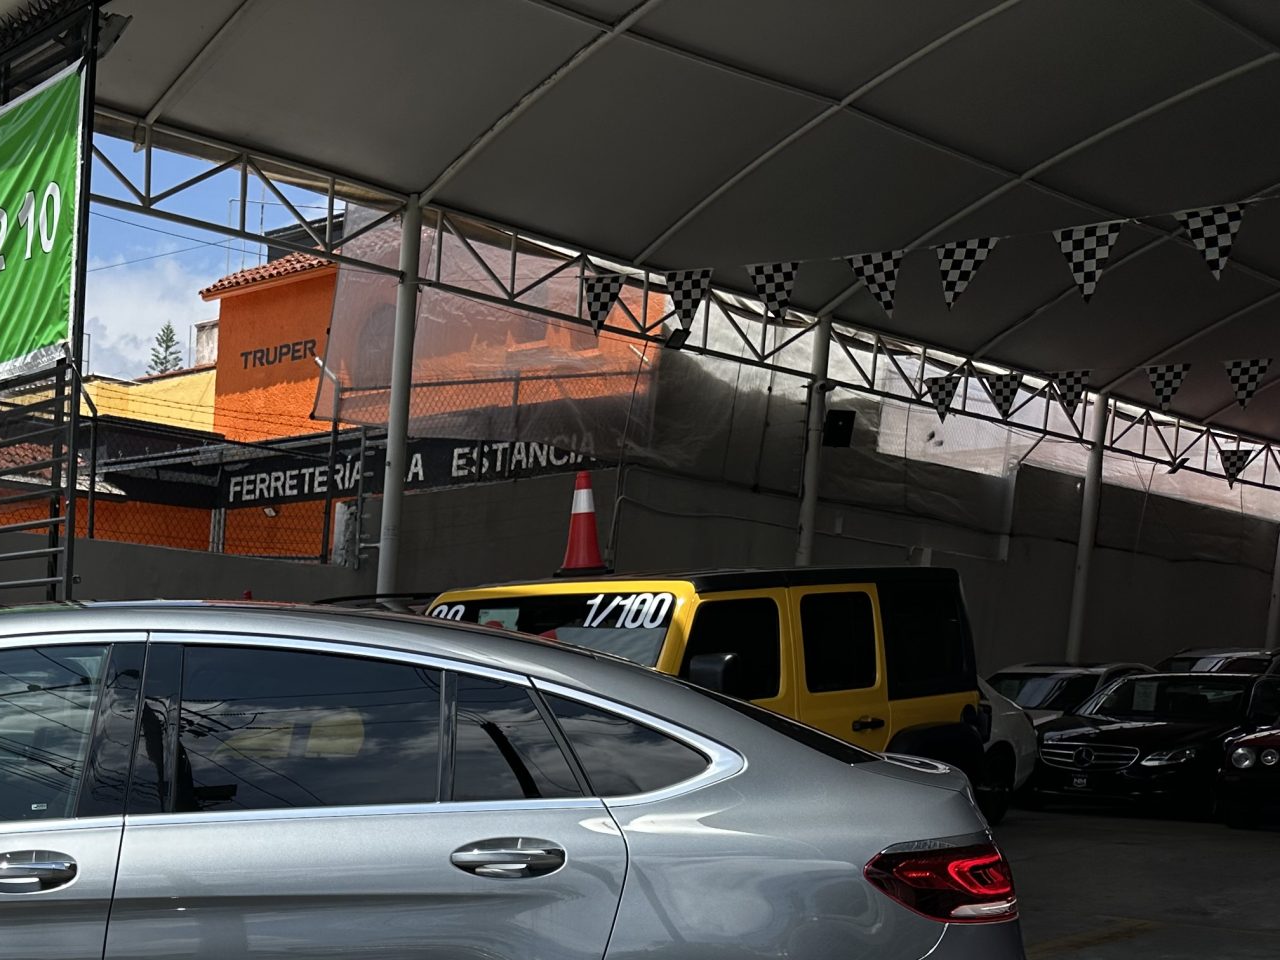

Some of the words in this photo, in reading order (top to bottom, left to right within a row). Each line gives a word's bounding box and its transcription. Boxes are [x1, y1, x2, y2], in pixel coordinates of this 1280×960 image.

[17, 181, 62, 260] 10
[240, 338, 317, 369] TRUPER
[451, 432, 598, 478] ESTANCIA
[582, 592, 673, 629] 1/100
